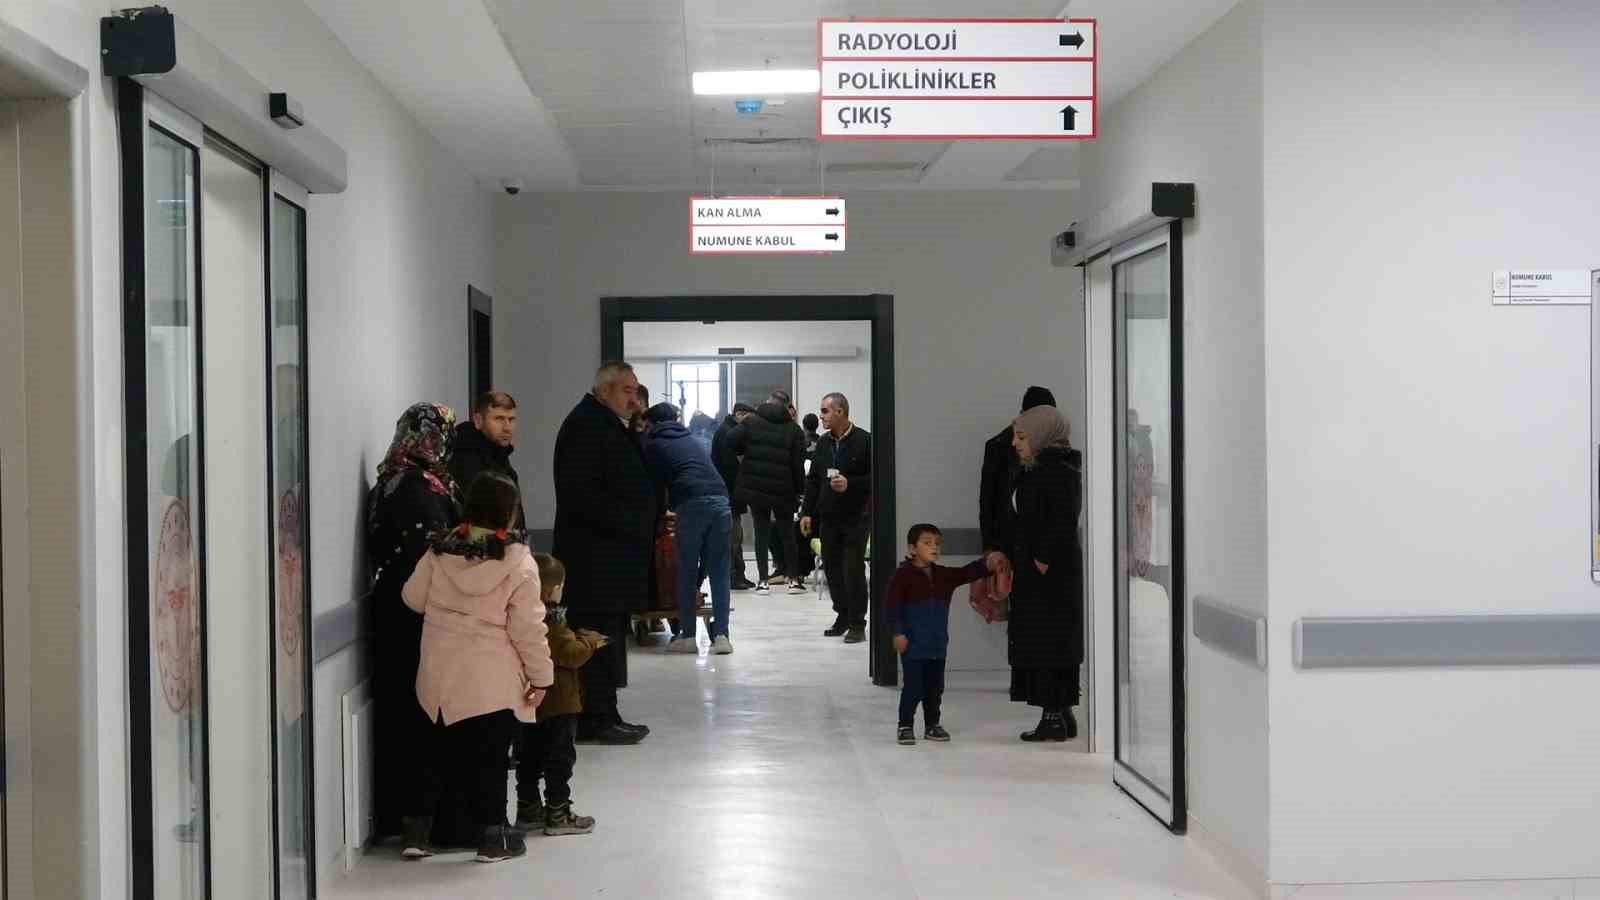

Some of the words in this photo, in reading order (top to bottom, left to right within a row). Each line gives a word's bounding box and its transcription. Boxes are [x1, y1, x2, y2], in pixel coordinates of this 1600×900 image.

[838, 29, 957, 51] RADYOLOJİ
[838, 68, 996, 90] POLİKLİNİKLER
[838, 106, 892, 129] ÇIKIŞ
[697, 207, 724, 218] KAN
[726, 207, 762, 218] ALMA
[698, 236, 752, 247] NUMUNE
[755, 236, 796, 246] KABUL
